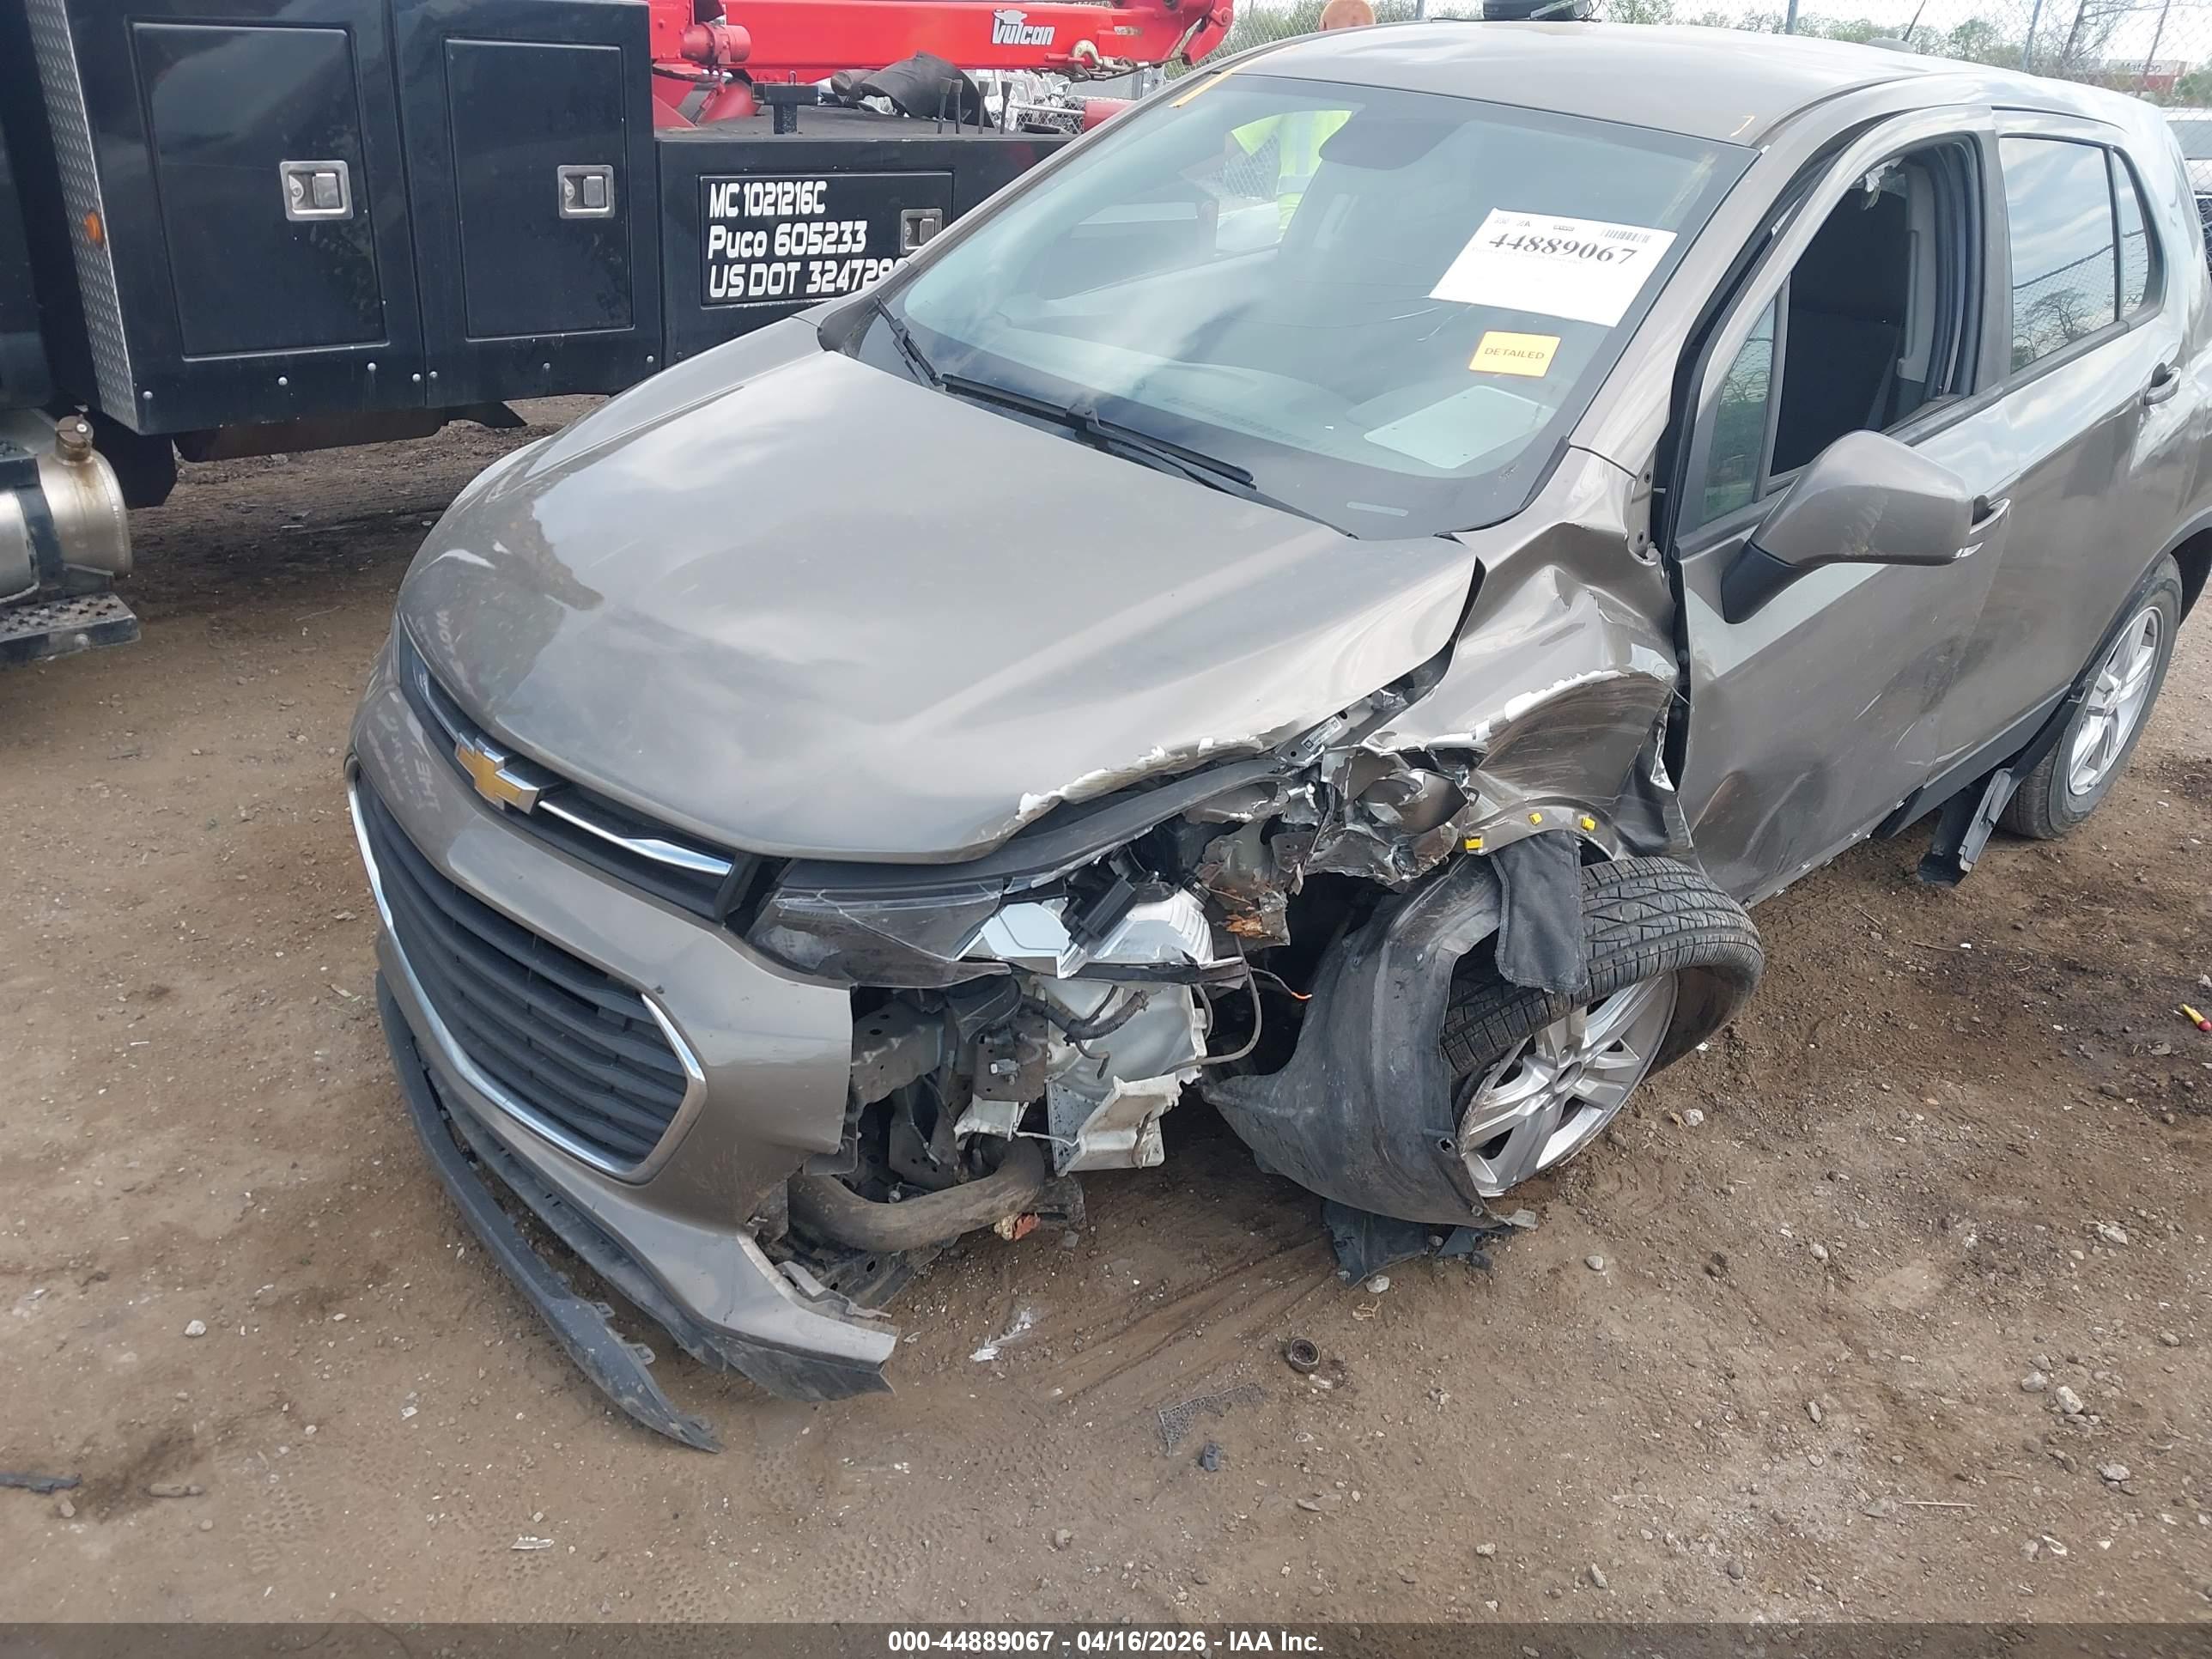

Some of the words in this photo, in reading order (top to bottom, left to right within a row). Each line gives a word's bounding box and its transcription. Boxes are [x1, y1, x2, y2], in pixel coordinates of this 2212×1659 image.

[992, 18, 1055, 45] Vulcan
[709, 183, 739, 218] MC
[744, 180, 828, 216] 1021216C
[708, 224, 768, 259] Puco
[774, 221, 867, 256] 605233
[1488, 233, 1638, 265] 44889067
[1484, 347, 1545, 359] DETAILED
